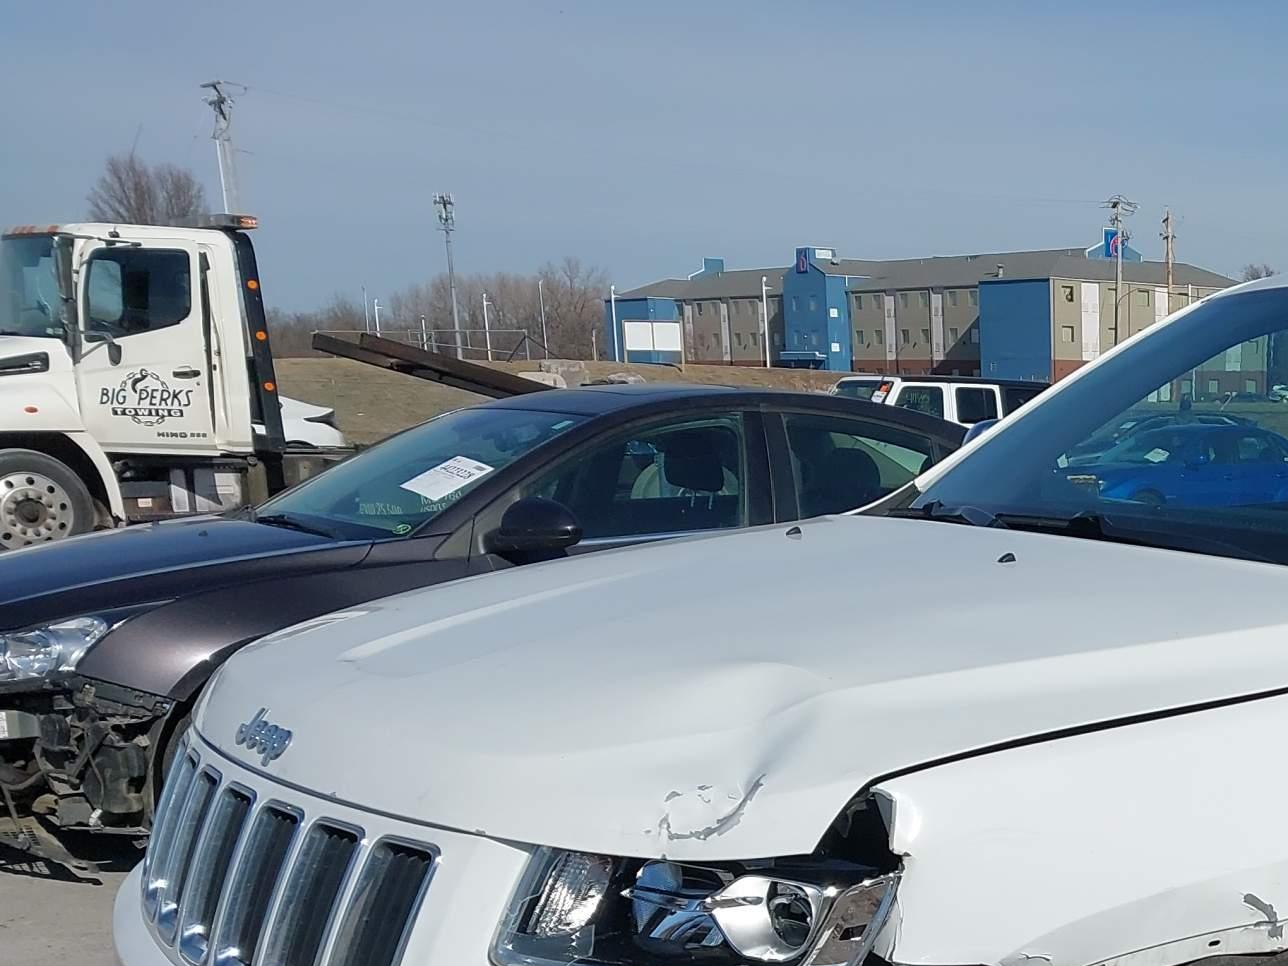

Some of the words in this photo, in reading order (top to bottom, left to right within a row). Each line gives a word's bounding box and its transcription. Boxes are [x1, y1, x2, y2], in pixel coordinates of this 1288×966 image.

[100, 387, 128, 405] BIG
[137, 388, 194, 407] PERKS
[114, 408, 181, 416] TOWING
